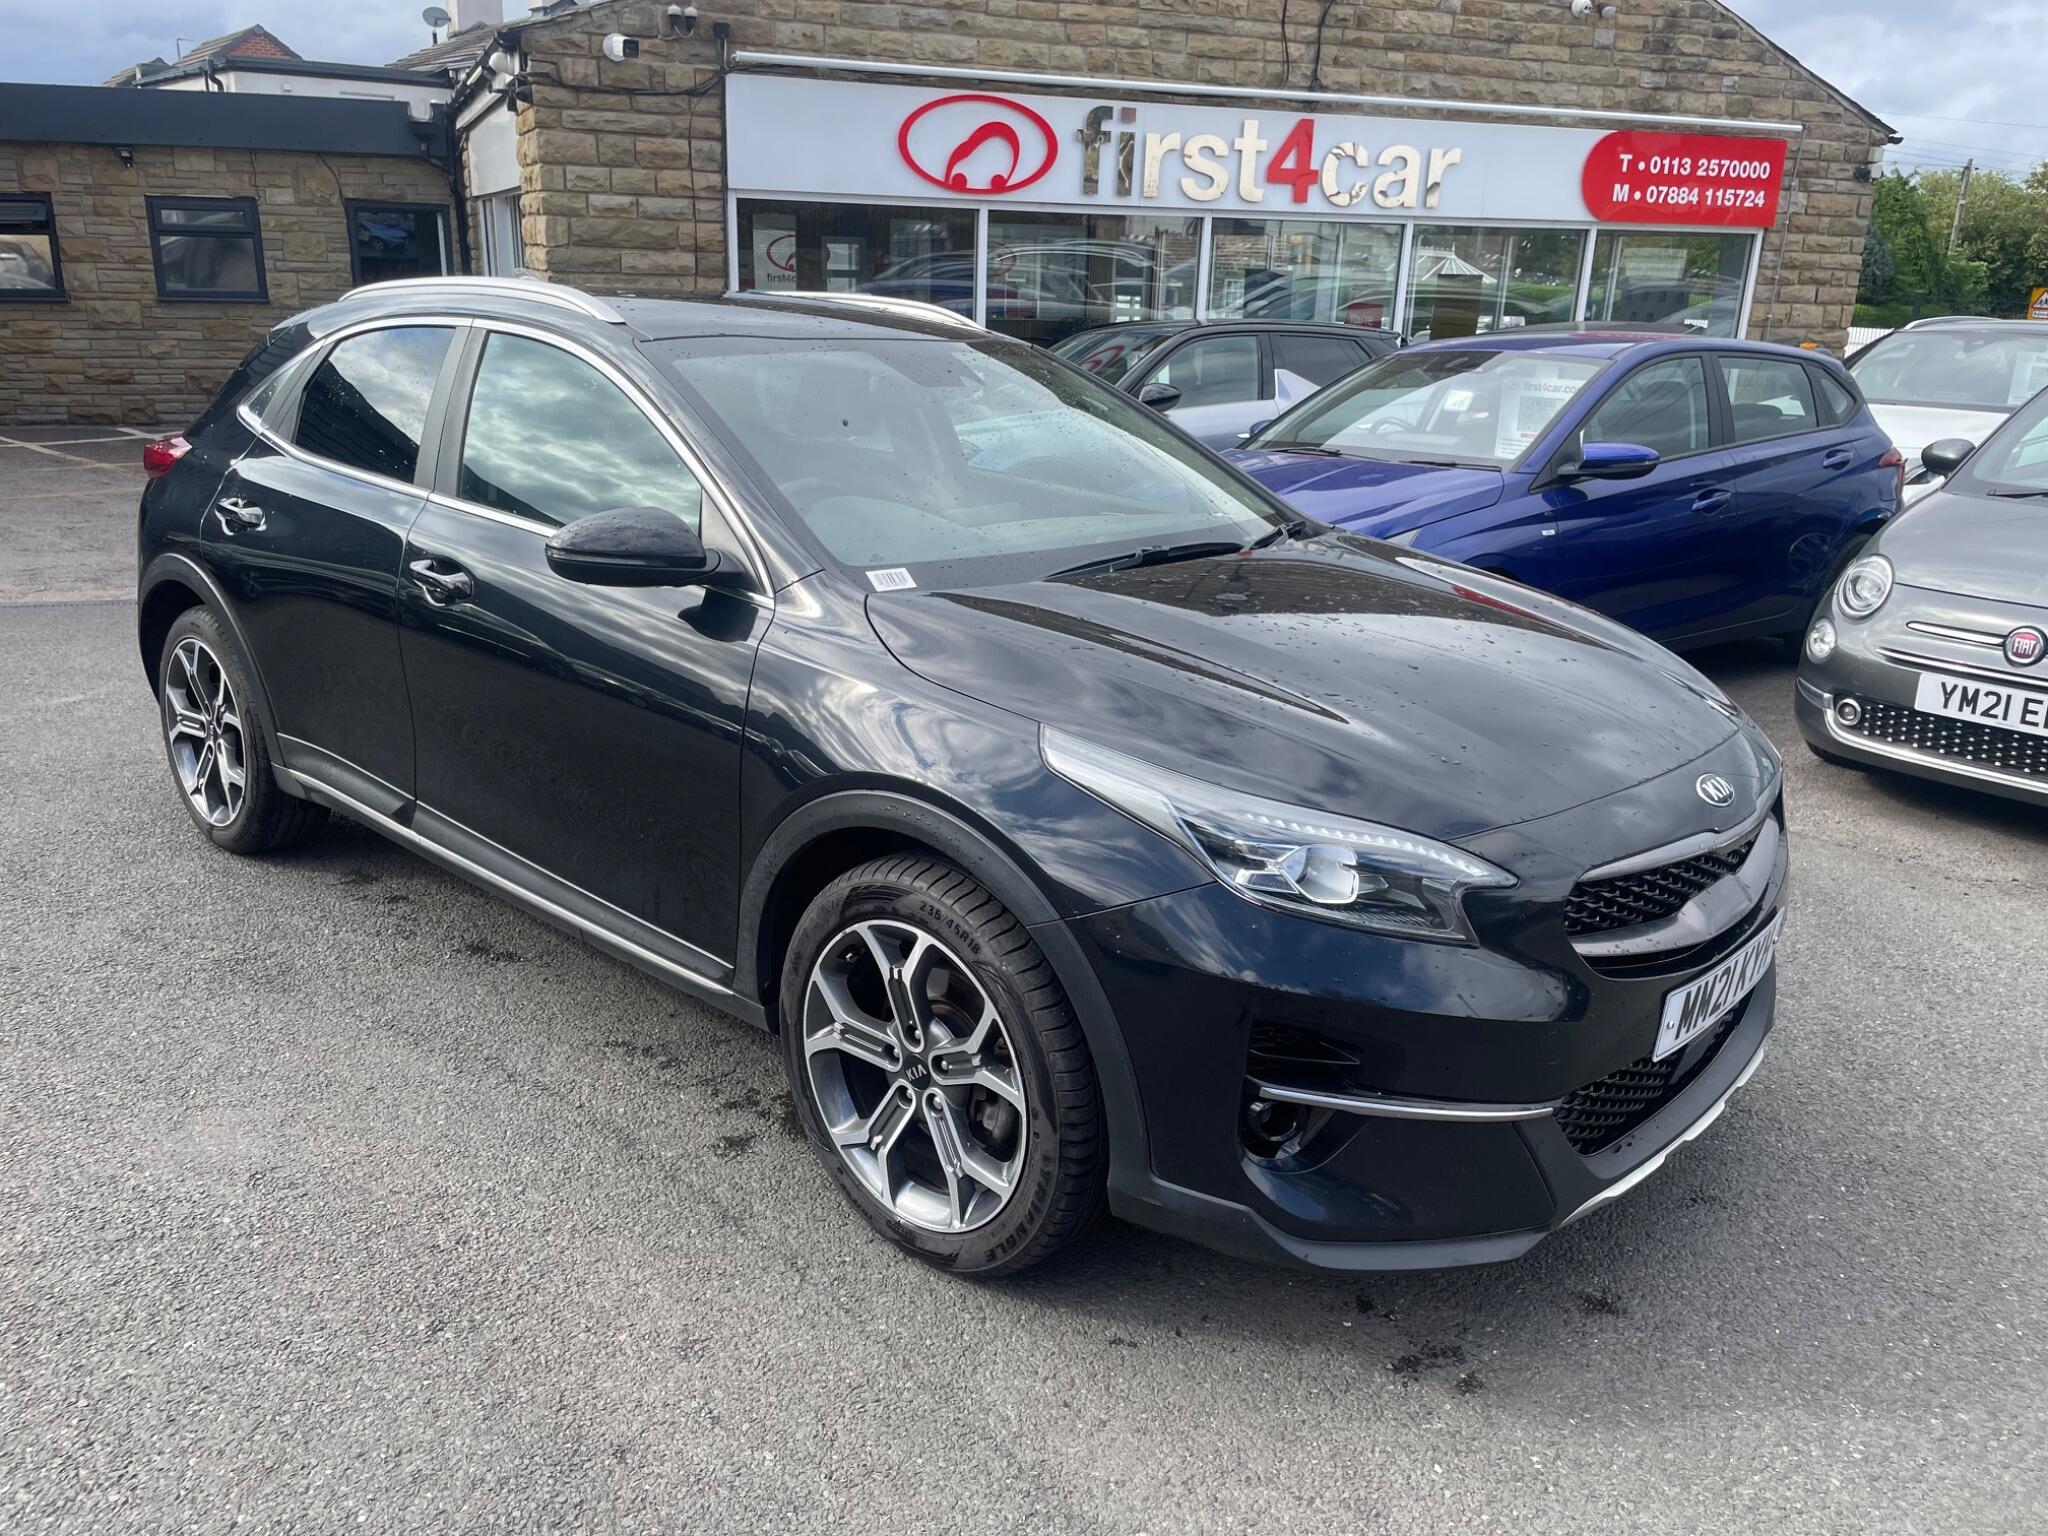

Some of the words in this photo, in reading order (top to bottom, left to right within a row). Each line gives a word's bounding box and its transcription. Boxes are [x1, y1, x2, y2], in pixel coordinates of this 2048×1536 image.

[1076, 105, 1462, 209] first4car
[1619, 154, 1633, 173] T
[1650, 156, 1692, 175] 0113
[1696, 159, 1771, 180] 2570000
[1612, 184, 1630, 202] M
[1646, 185, 1699, 205] 07884
[1705, 188, 1765, 208] 115724
[1523, 381, 1581, 394] first4car.co
[2012, 638, 2037, 656] FIAT
[1940, 681, 2013, 722] YM21
[2019, 697, 2048, 729] E
[1701, 776, 1733, 801] KIA
[1674, 959, 1739, 1041] MM21
[905, 1064, 928, 1081] KIA
